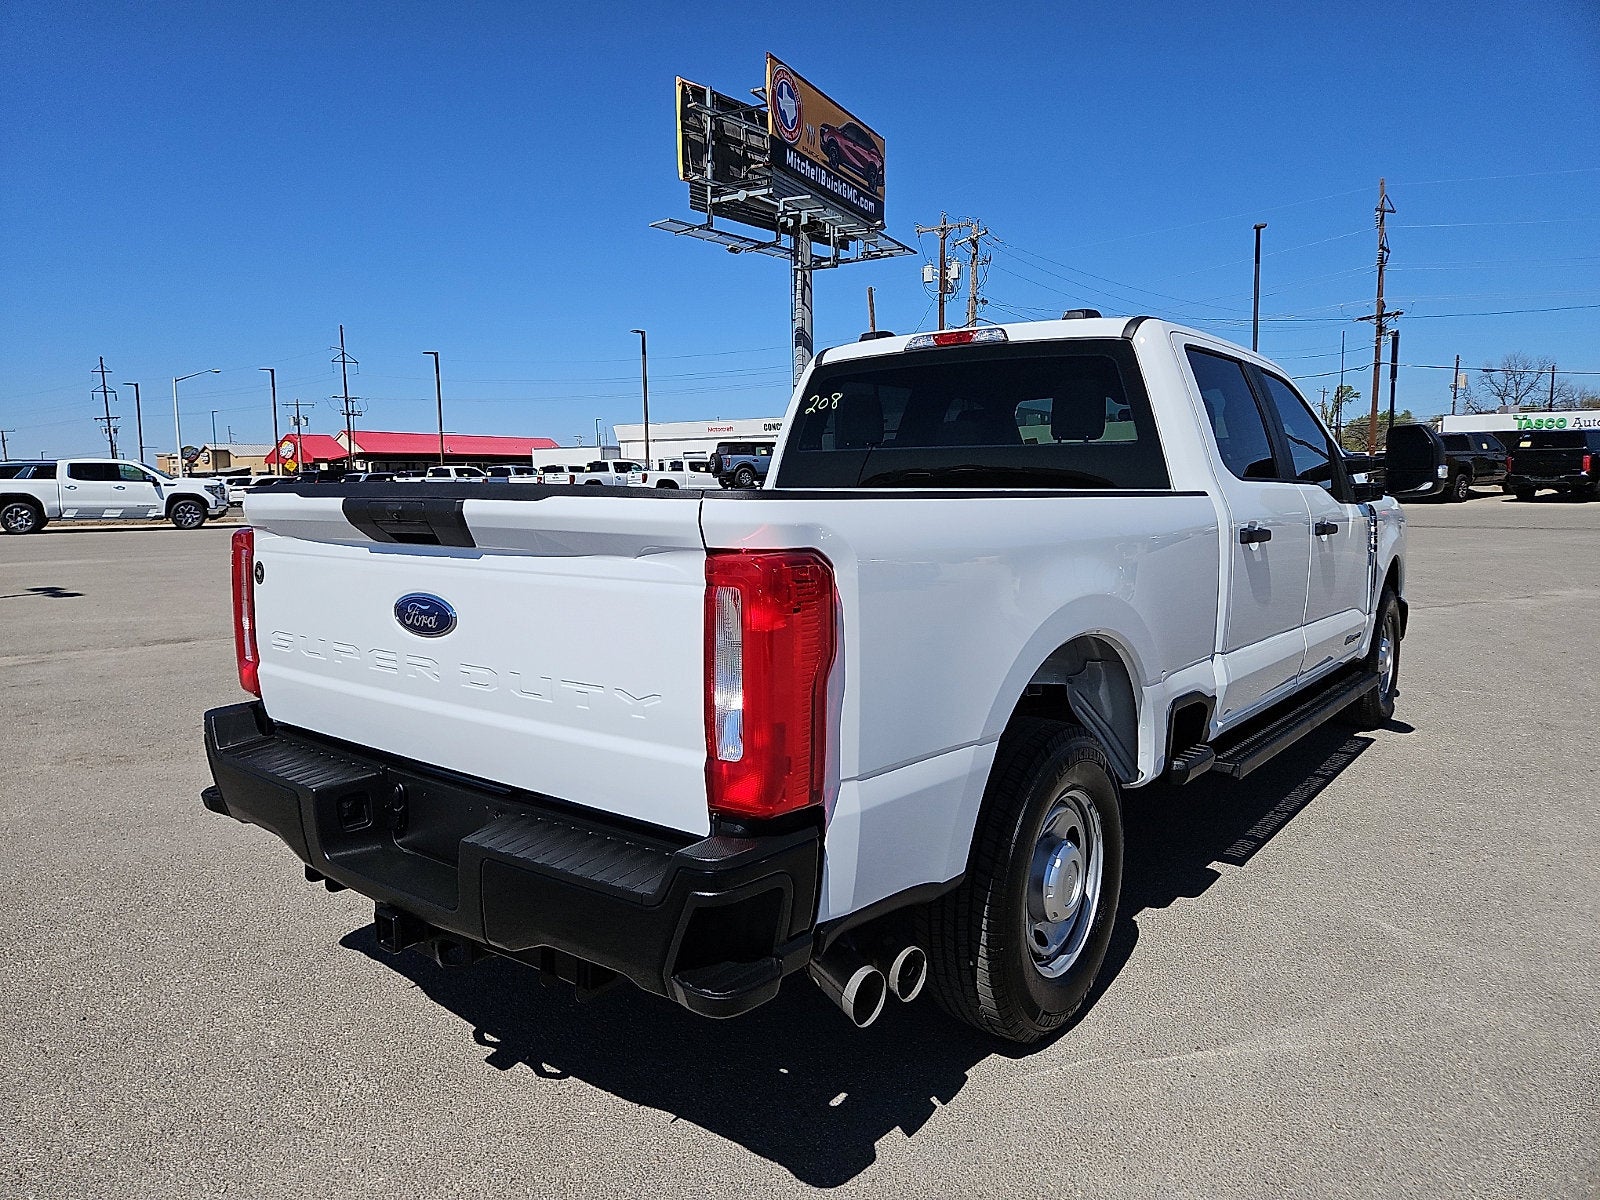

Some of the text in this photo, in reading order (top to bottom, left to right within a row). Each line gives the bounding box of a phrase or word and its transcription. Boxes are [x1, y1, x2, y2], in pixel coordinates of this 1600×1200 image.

[786, 148, 875, 214] MitchellBuickGMC.com
[804, 392, 843, 414] 208
[763, 422, 783, 432] CONC
[1512, 414, 1567, 430] TASCO
[404, 602, 439, 629] Ford
[271, 629, 663, 719] SUPER DUTY
